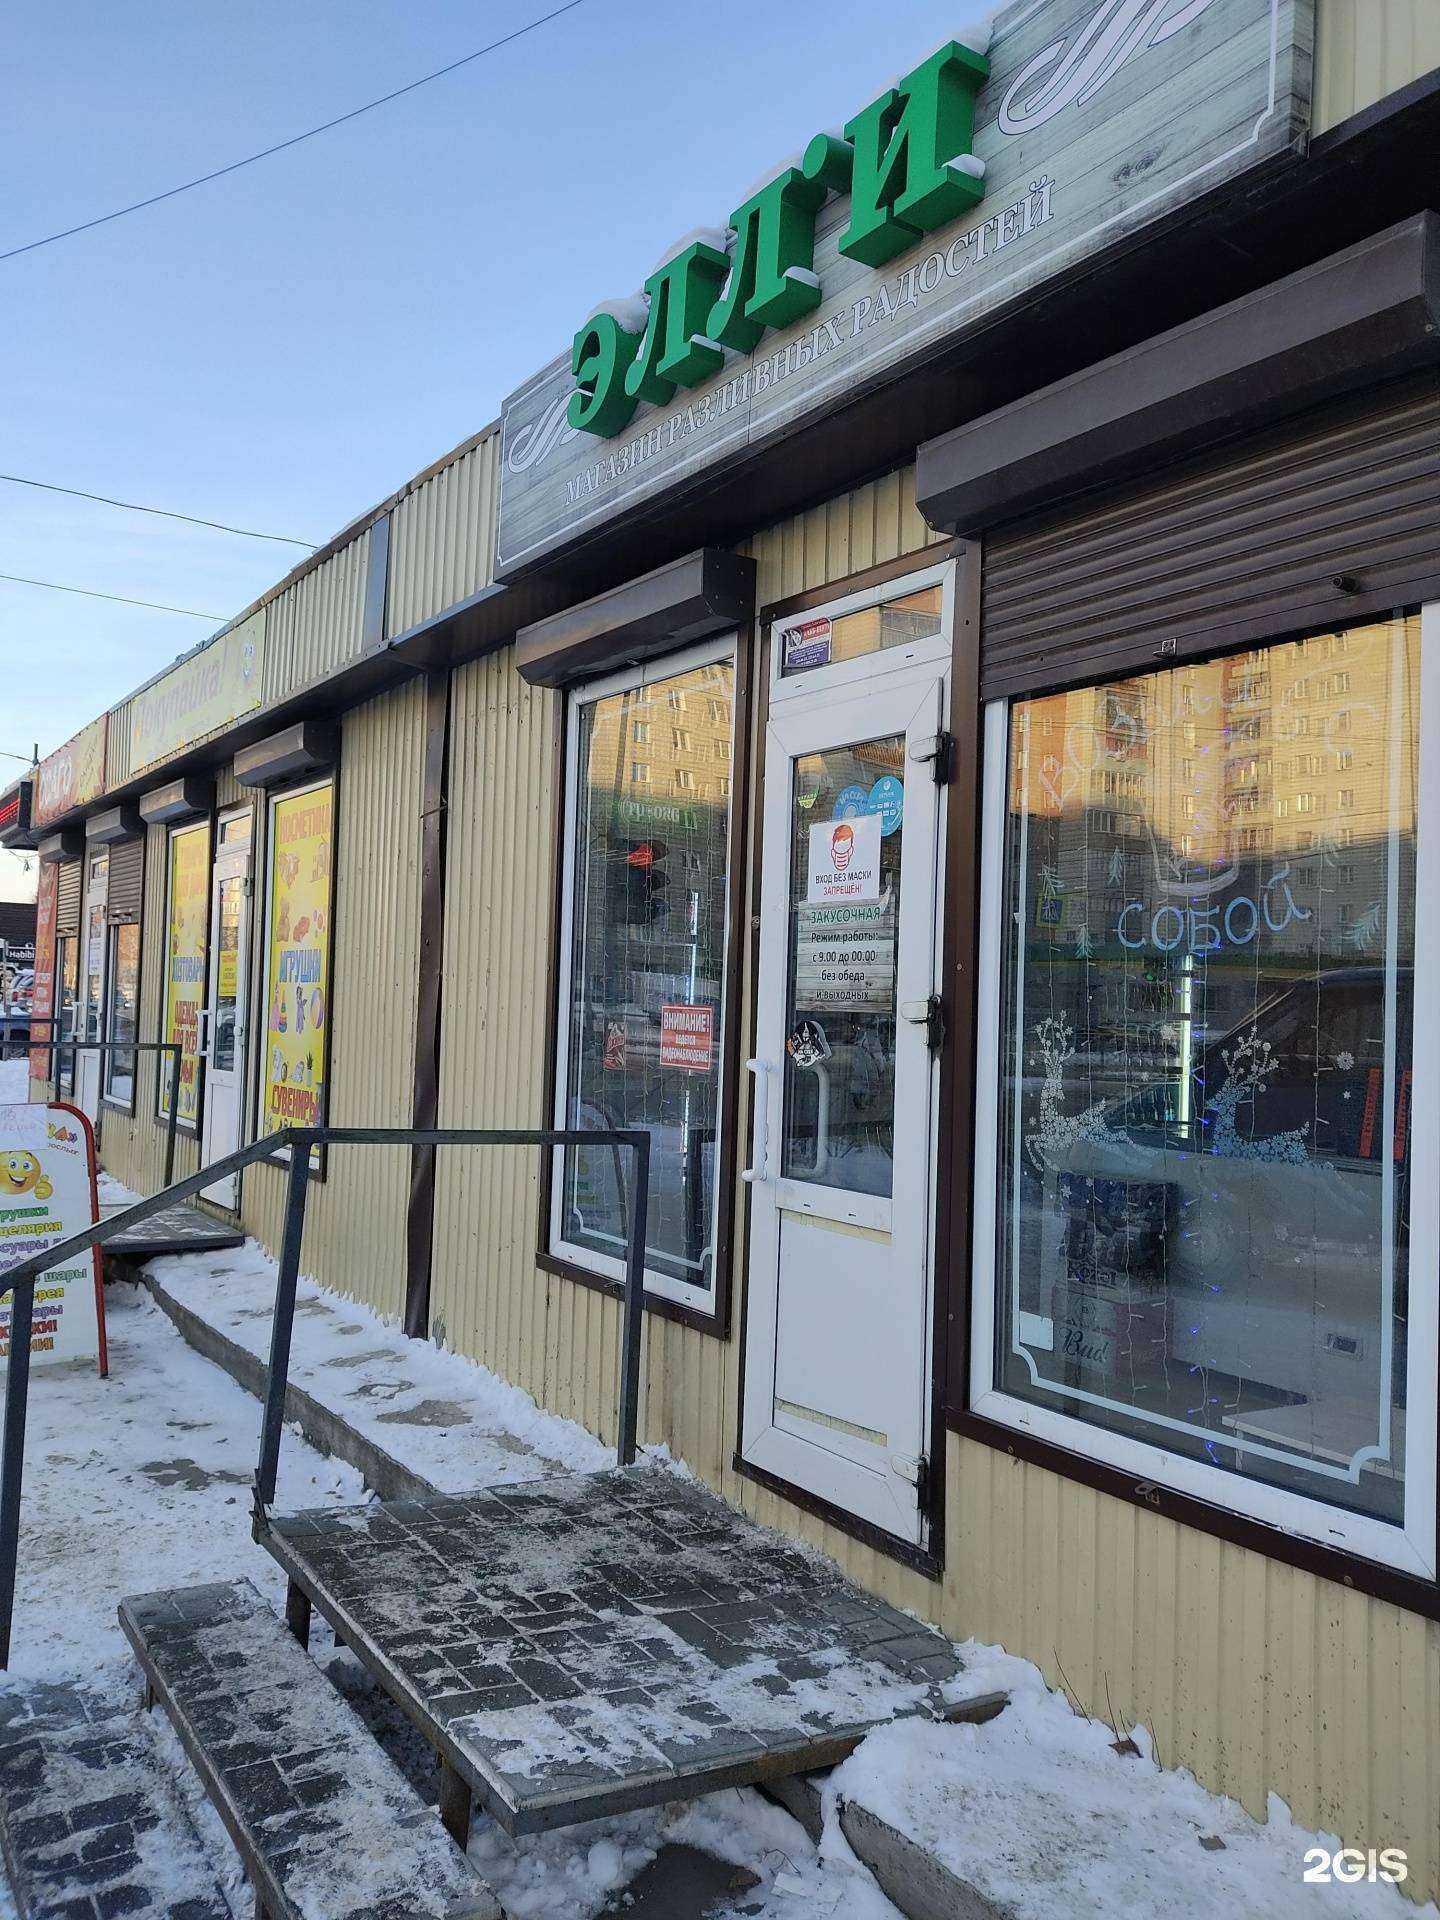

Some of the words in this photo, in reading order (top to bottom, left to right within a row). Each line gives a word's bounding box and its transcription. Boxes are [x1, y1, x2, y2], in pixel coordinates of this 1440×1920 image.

[565, 423, 664, 505] МАГАЗИН
[667, 311, 847, 447] РАЗЛИВНЫХ
[850, 175, 1056, 338] РАДОСТЕЙ
[815, 873, 833, 885] ВХОД
[834, 872, 847, 883] БЕЗ
[847, 870, 872, 881] МАСКИ
[811, 906, 881, 924] ЗАКУСОЧНАЯ
[811, 932, 840, 943] Режим
[842, 930, 879, 944] работы:
[812, 953, 817, 962] с
[819, 951, 837, 962] 9.00
[838, 952, 850, 965] до
[851, 950, 876, 962] 00.00
[278, 949, 322, 984] ИГРУШКИ
[821, 969, 838, 981] без
[838, 969, 865, 982] обеда
[816, 991, 821, 999] и
[825, 990, 869, 1001] выходных
[663, 1011, 710, 1034] ВНИМАНИЕ!
[271, 1084, 321, 1123] СУВЕНИРЫ
[43, 1267, 88, 1283] шары
[1060, 1325, 1111, 1363] Bud
